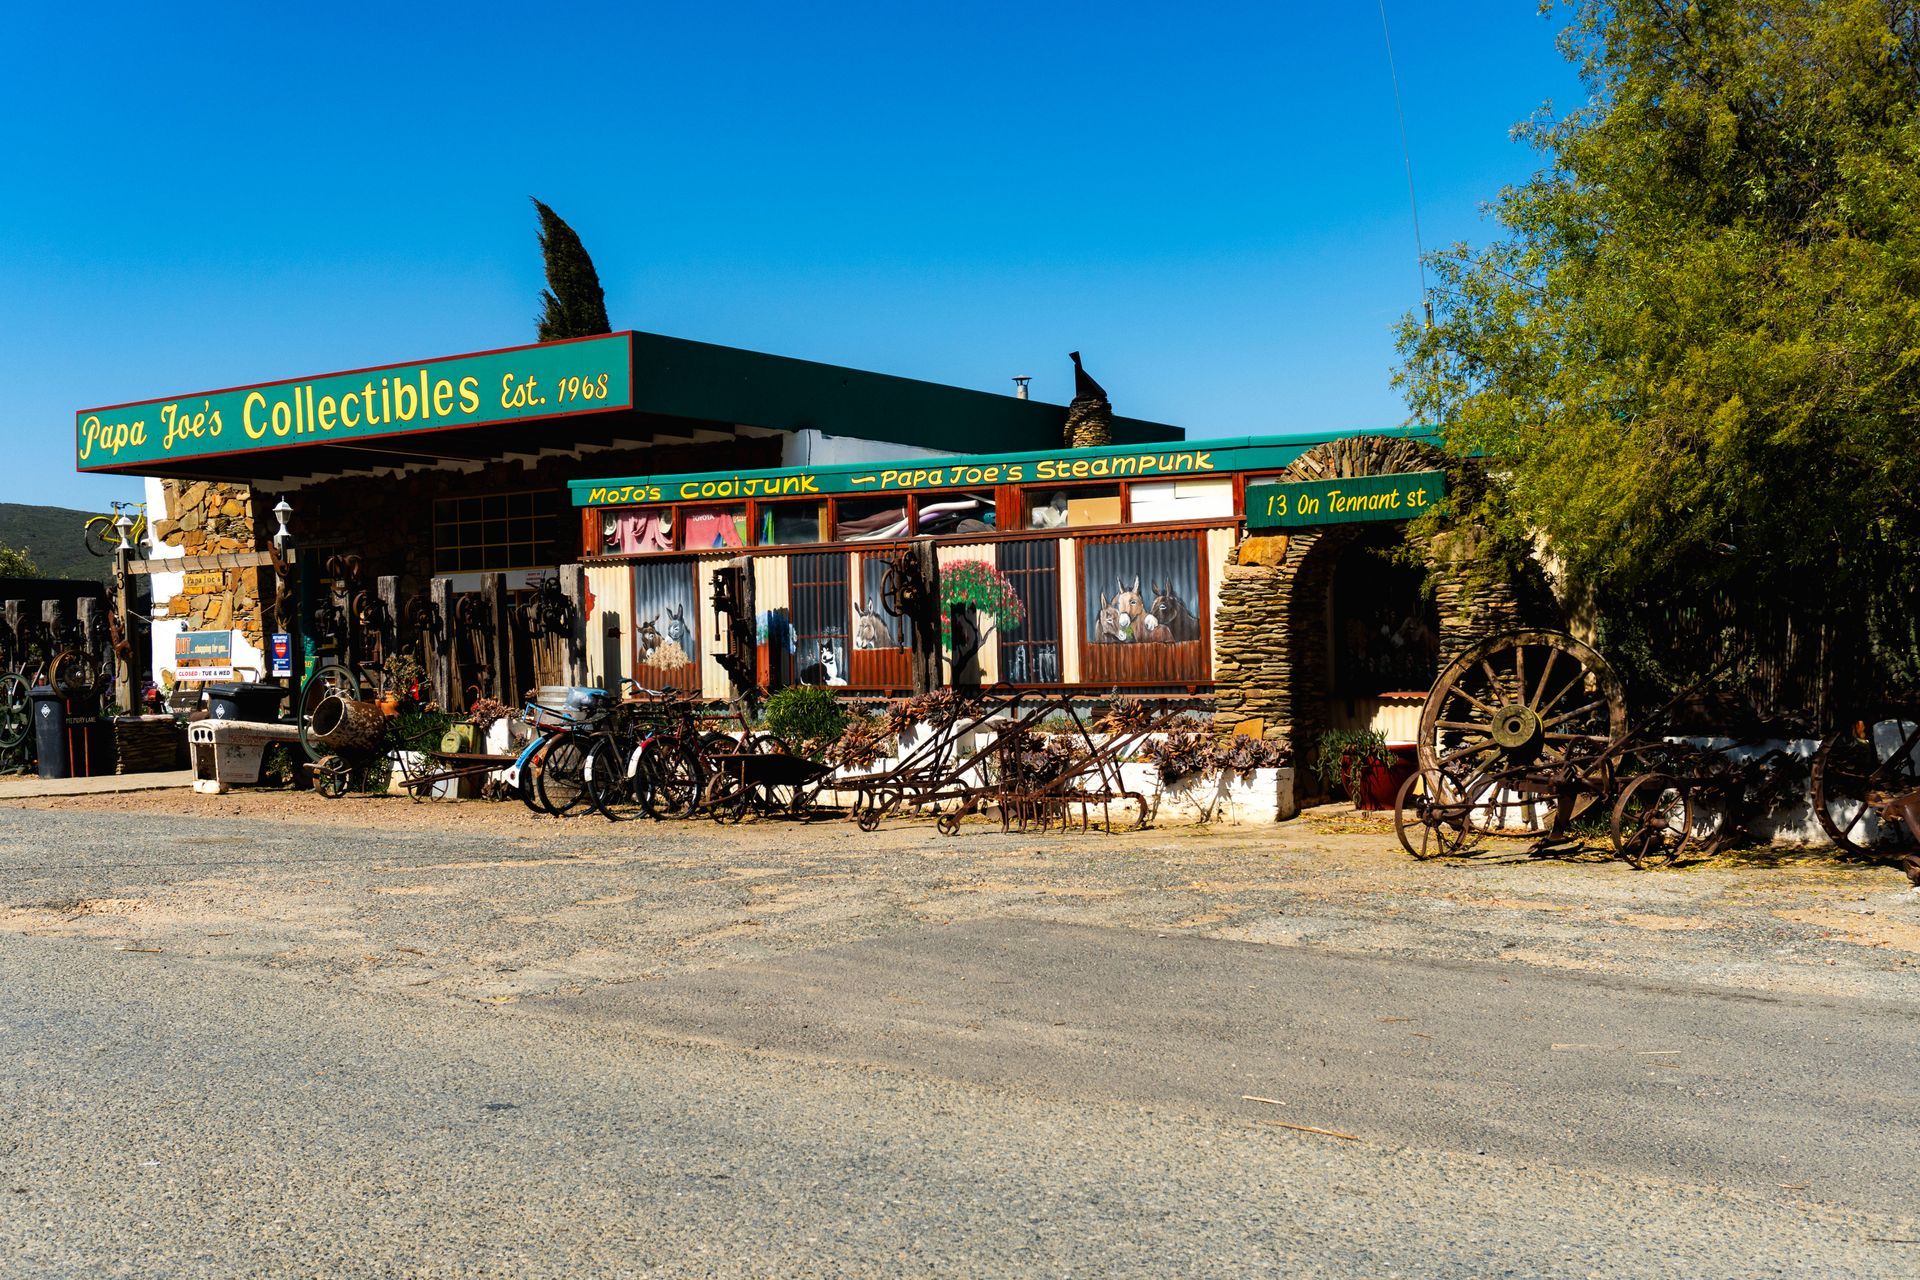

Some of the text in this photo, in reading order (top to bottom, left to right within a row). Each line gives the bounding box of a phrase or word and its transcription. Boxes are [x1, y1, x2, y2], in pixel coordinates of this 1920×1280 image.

[79, 369, 608, 460] Papa Joe's Collectibles Est. 1968
[880, 470, 942, 489] Papa
[950, 464, 1023, 484] Joe's
[1036, 451, 1214, 479] Steampunk
[1267, 494, 1287, 516] 13
[1297, 494, 1319, 515] On
[1327, 488, 1401, 512] Tennant
